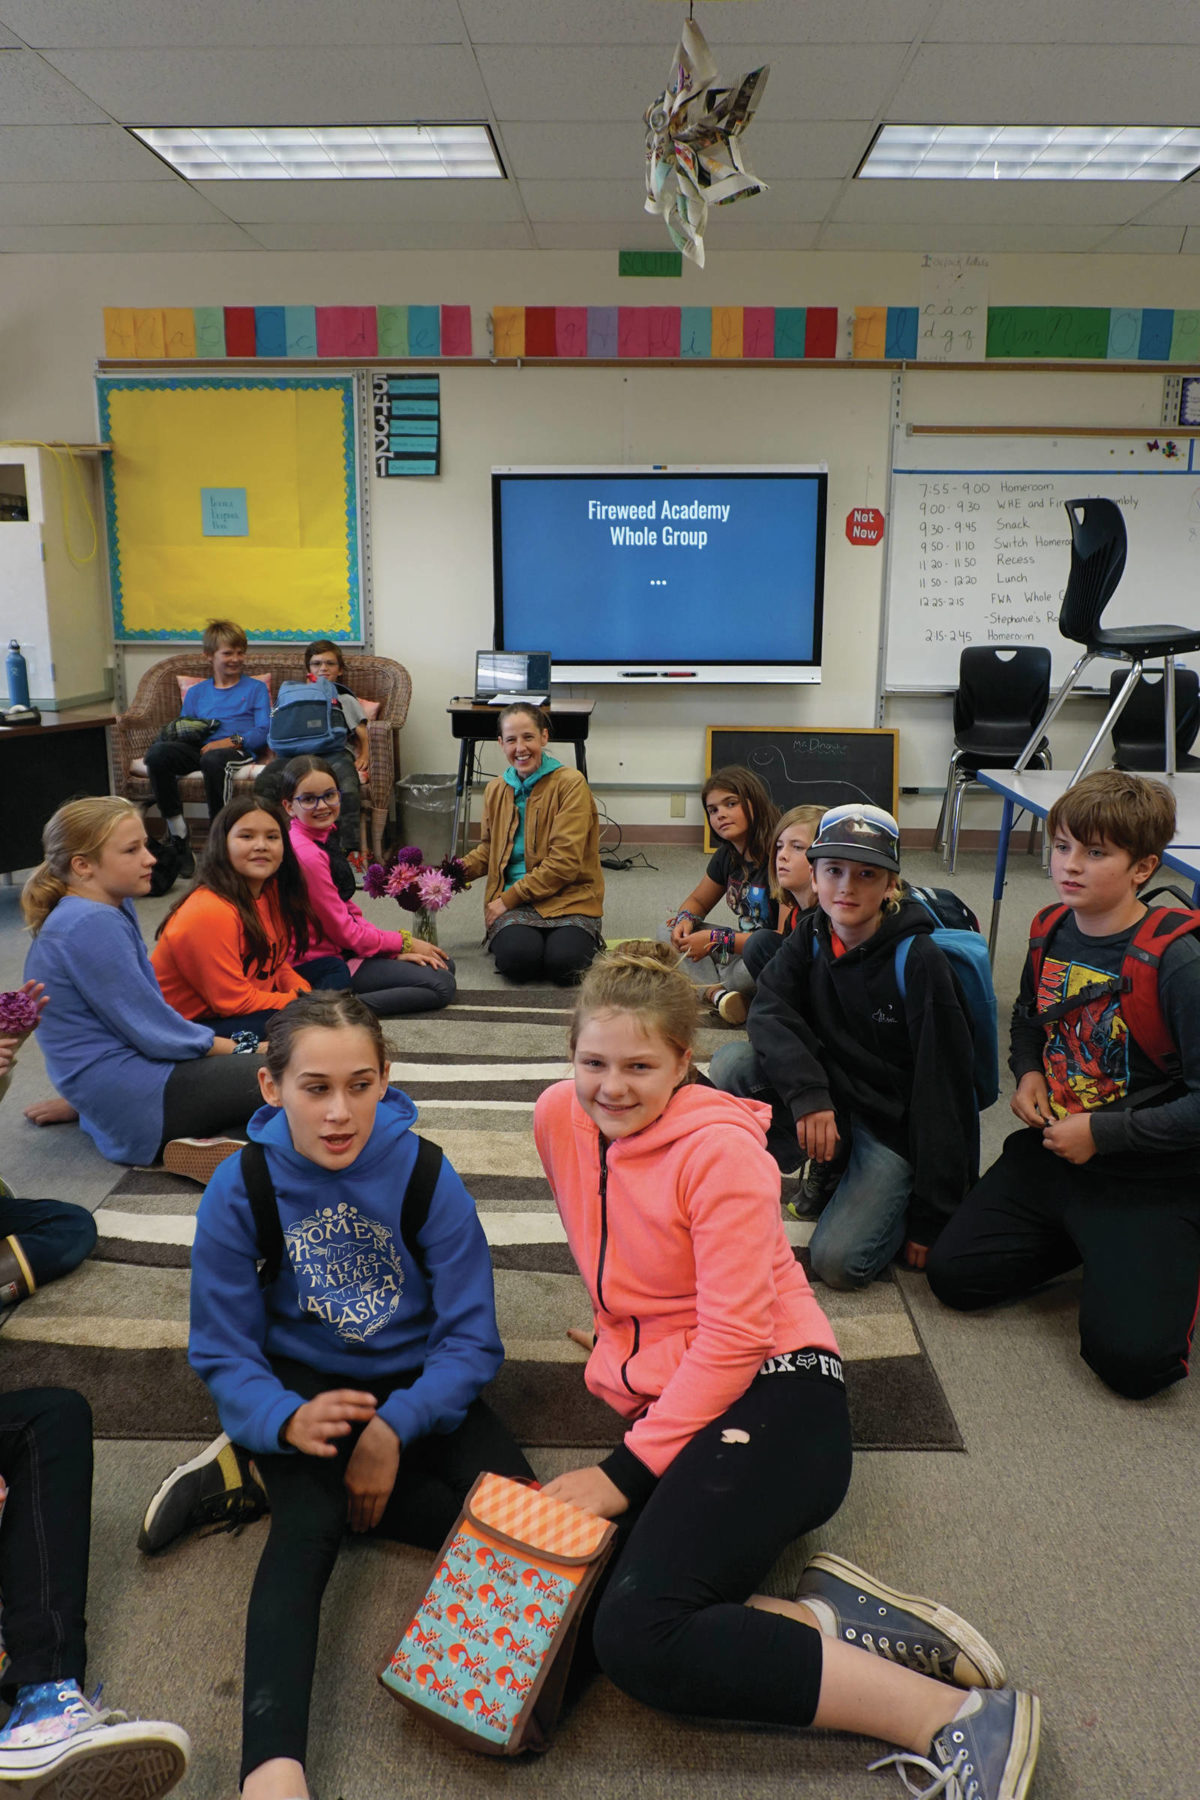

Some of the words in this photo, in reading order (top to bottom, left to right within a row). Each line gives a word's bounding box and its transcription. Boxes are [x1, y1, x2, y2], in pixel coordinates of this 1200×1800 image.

[373, 375, 389, 394] 5
[373, 395, 391, 415] 4
[374, 415, 389, 436] 3
[374, 436, 395, 458] 2
[377, 457, 387, 477] 1
[919, 483, 949, 498] 7:55
[962, 481, 991, 495] 900
[1001, 481, 1055, 493] Homeroom
[588, 500, 656, 520] Fireweed
[660, 500, 730, 523] Academy
[854, 510, 874, 523] Not
[920, 502, 946, 516] 900
[957, 500, 981, 512] 930
[997, 499, 1021, 509] WHE
[1028, 498, 1045, 509] and
[853, 526, 878, 539] Now
[920, 521, 944, 537] 930
[997, 516, 1031, 531] Snack
[610, 526, 657, 546] Whole
[662, 526, 708, 549] Group
[920, 541, 944, 554] 950
[955, 541, 975, 552] 1110
[994, 536, 1028, 550] Switch
[920, 559, 943, 570] 1120
[954, 557, 977, 568] 1150
[997, 553, 1036, 565] Recess
[920, 577, 942, 588] 1150
[997, 572, 1028, 584] Lunch
[1023, 591, 1052, 603] Whole
[295, 1218, 388, 1262] HOMER
[293, 1252, 377, 1276] FARMERS
[310, 1262, 383, 1288] MARKET
[306, 1275, 398, 1329] ALASKA
[760, 1352, 797, 1375] OX
